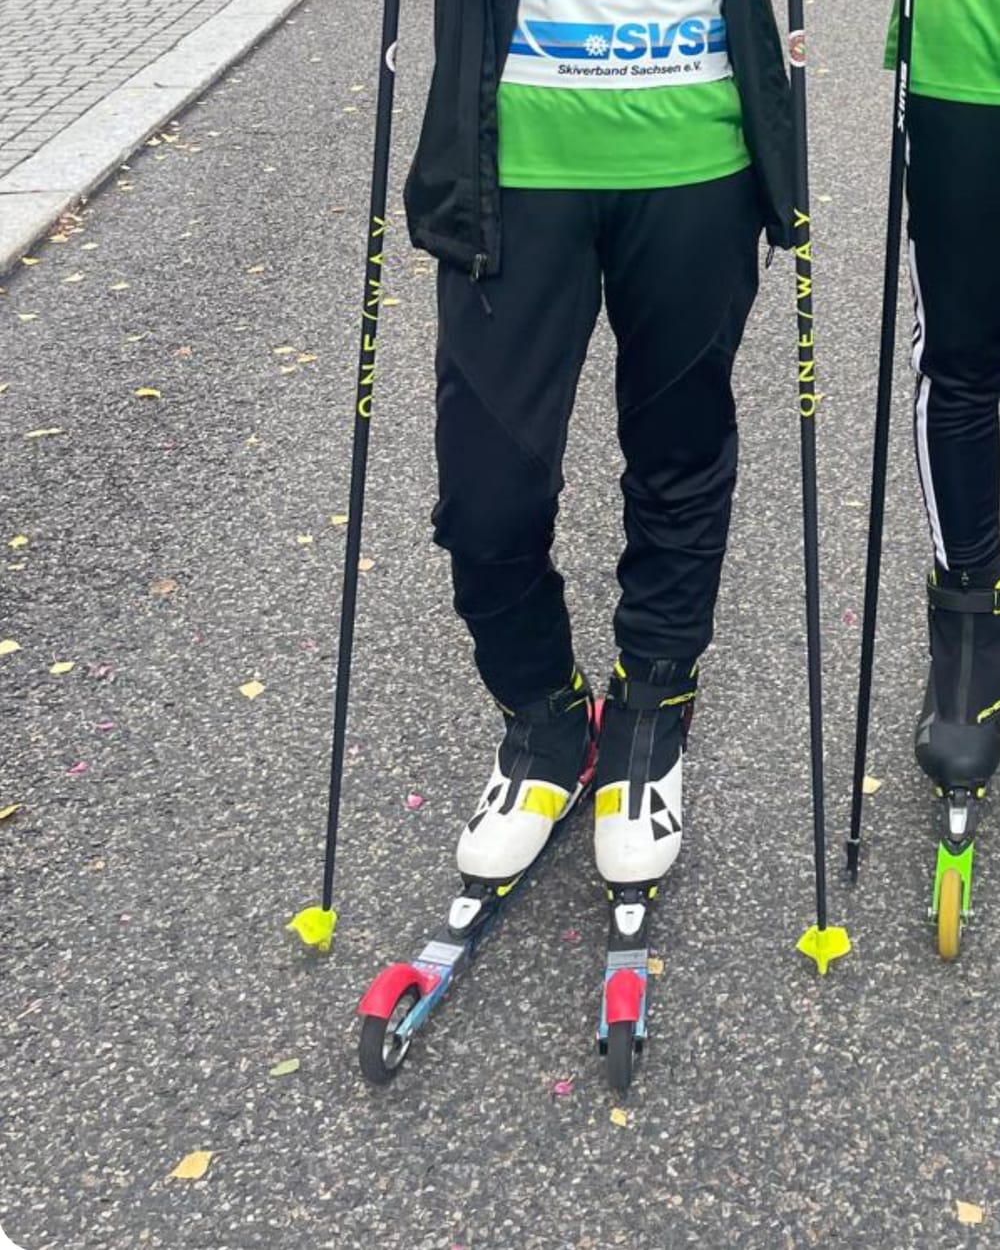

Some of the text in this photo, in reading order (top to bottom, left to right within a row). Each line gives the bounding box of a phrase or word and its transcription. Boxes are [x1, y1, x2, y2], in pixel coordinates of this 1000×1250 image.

[612, 18, 707, 60] SVS
[557, 64, 628, 77] Skiverband
[631, 64, 682, 76] Sachsen
[793, 208, 816, 417] ONE/WAY
